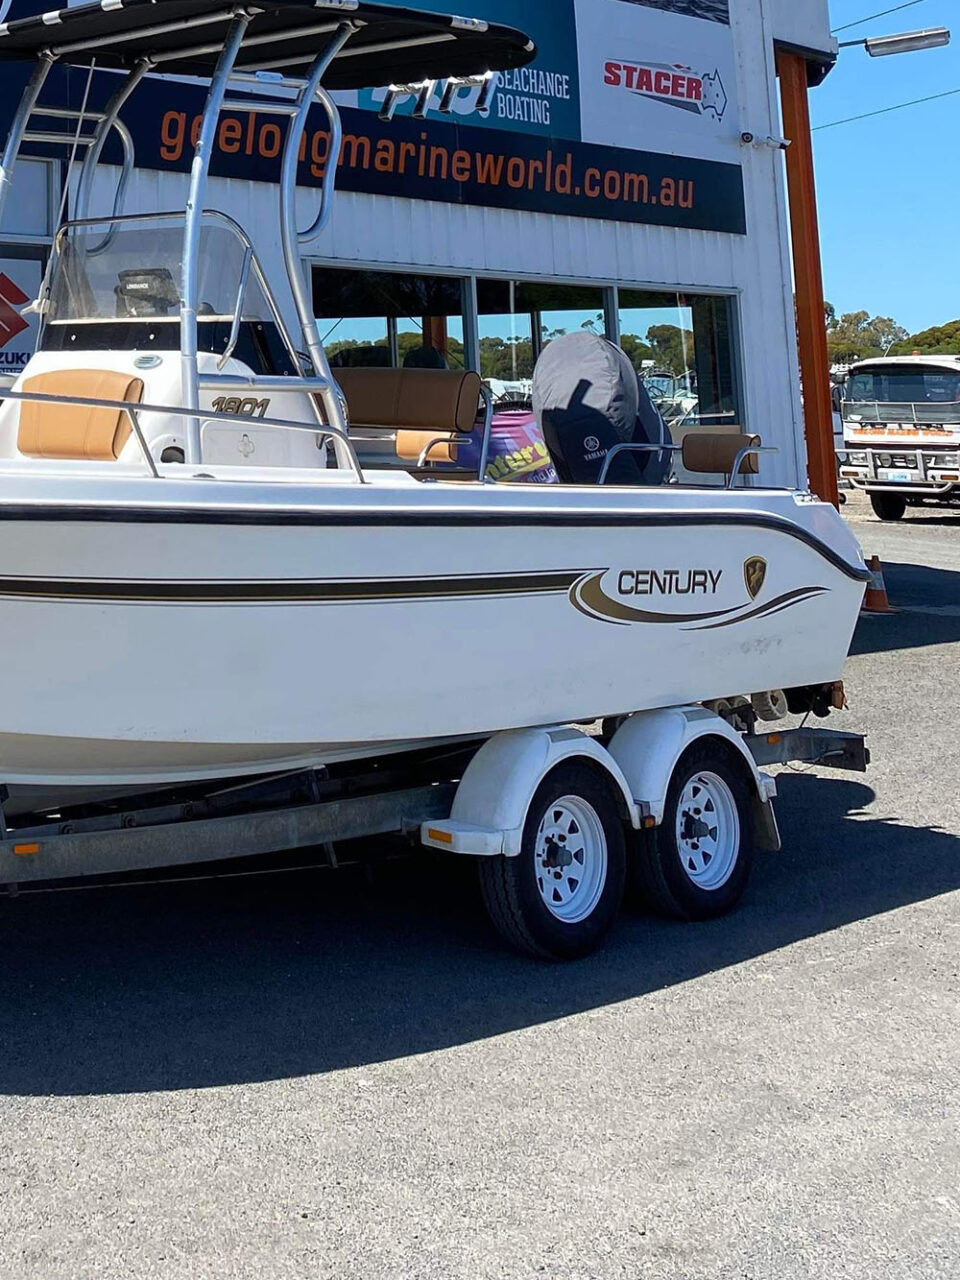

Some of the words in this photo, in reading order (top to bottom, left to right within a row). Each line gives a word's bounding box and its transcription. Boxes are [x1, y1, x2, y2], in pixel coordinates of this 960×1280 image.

[496, 68, 570, 99] SEACHANGE
[604, 62, 702, 100] STACER
[496, 93, 550, 124] BOATING
[212, 397, 271, 418] 1801
[617, 569, 722, 595] CENTURY
